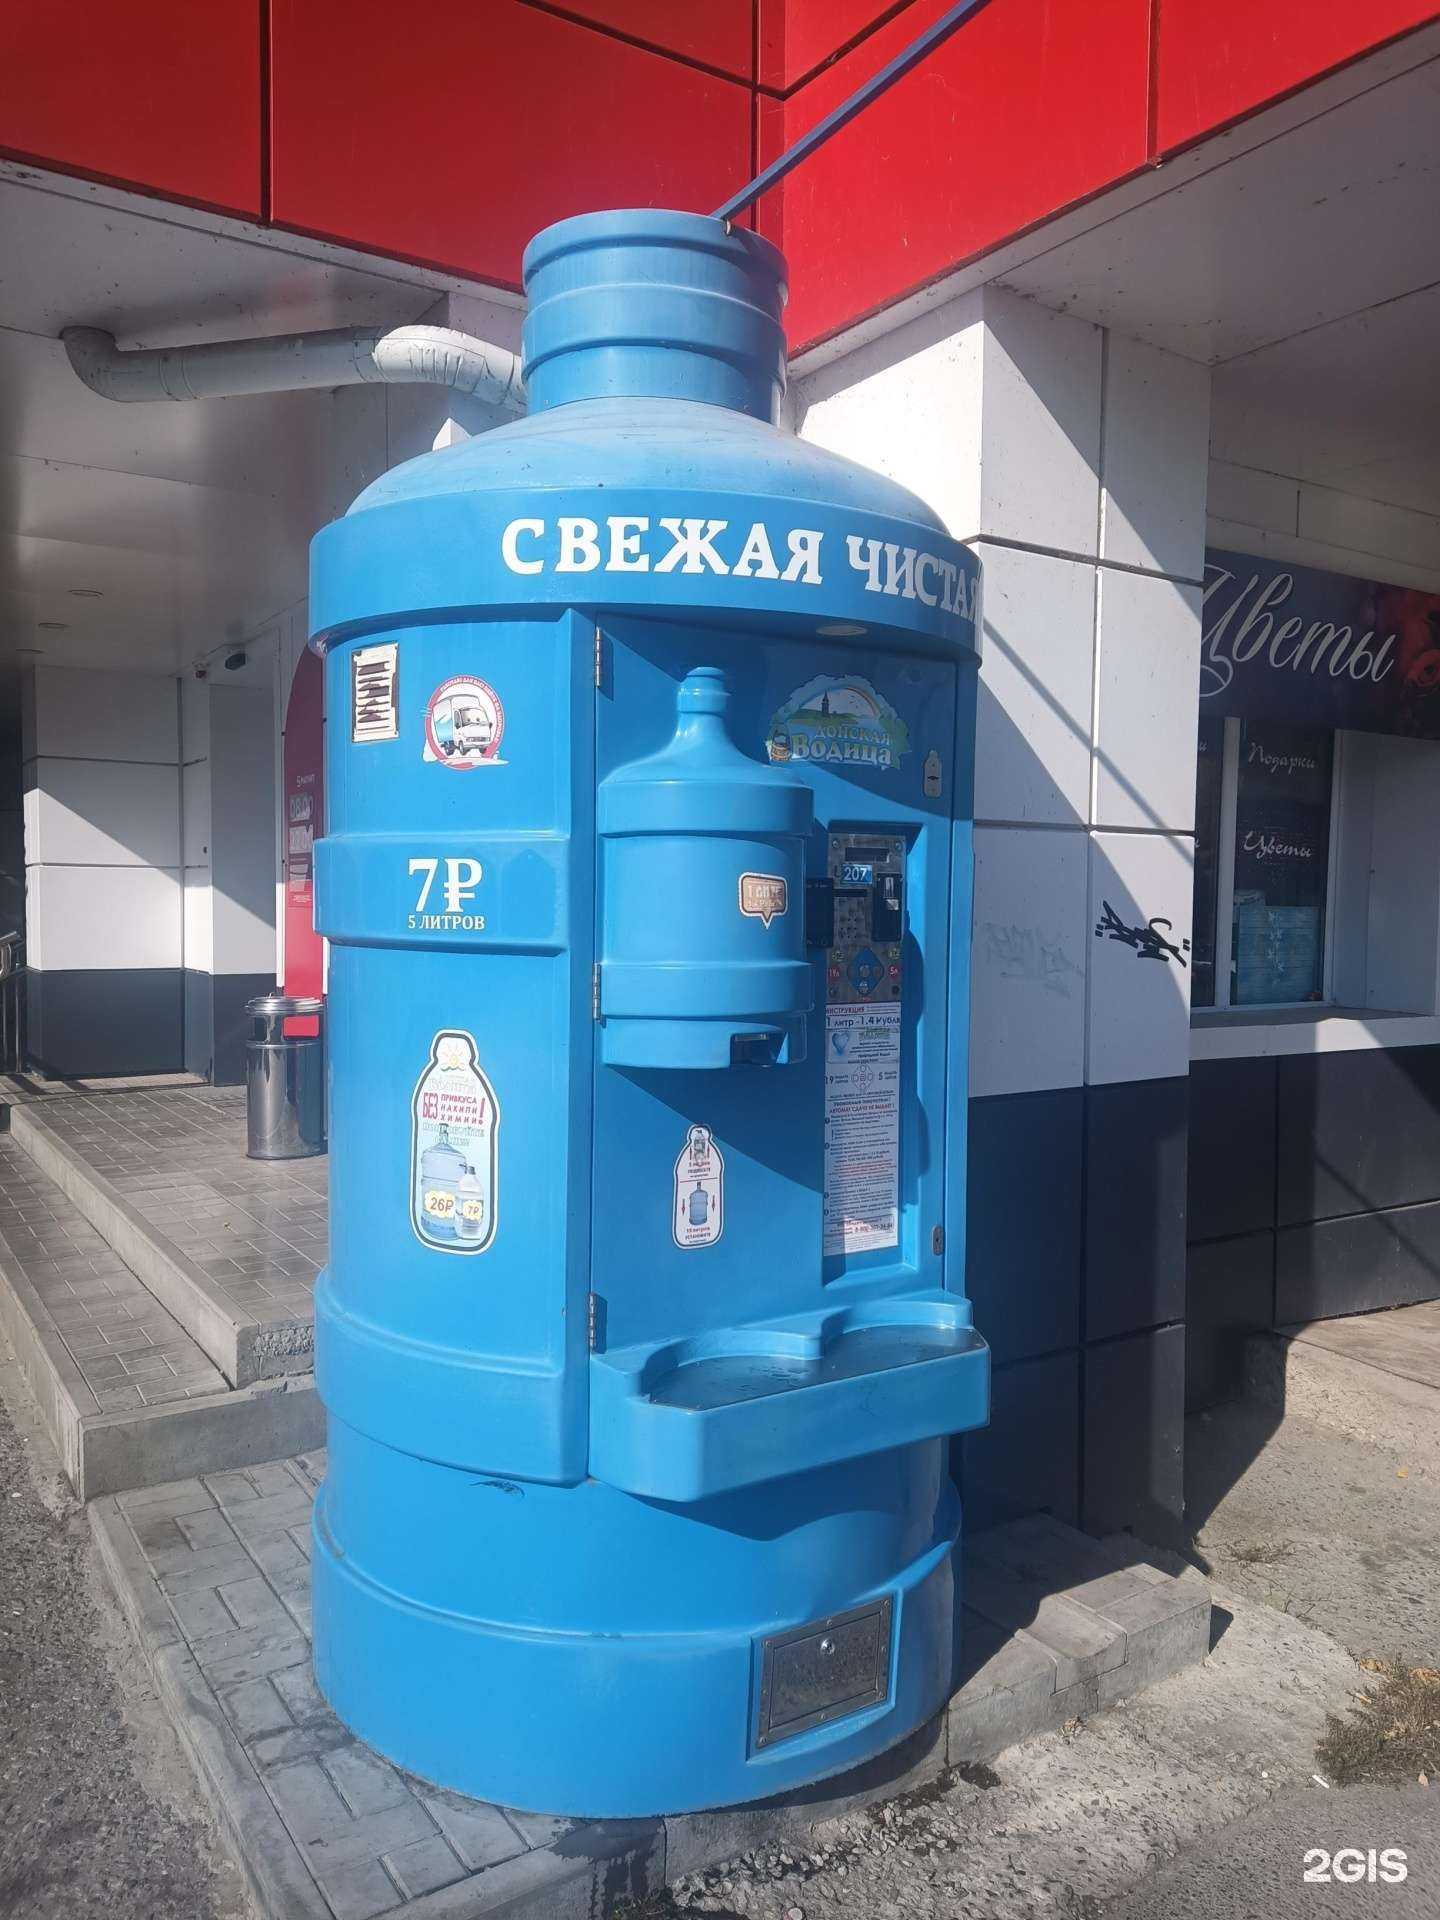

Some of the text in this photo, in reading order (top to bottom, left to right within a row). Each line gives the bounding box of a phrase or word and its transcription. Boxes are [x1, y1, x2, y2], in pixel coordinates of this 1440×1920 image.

[501, 516, 825, 585] СВЕЖАЯ
[1248, 741, 1317, 774] Подарки
[1242, 830, 1313, 859] Цветы
[408, 915, 485, 929] 5 ЛИТРОВ
[422, 1092, 477, 1120] БЕЗ ПРИВКУСА
